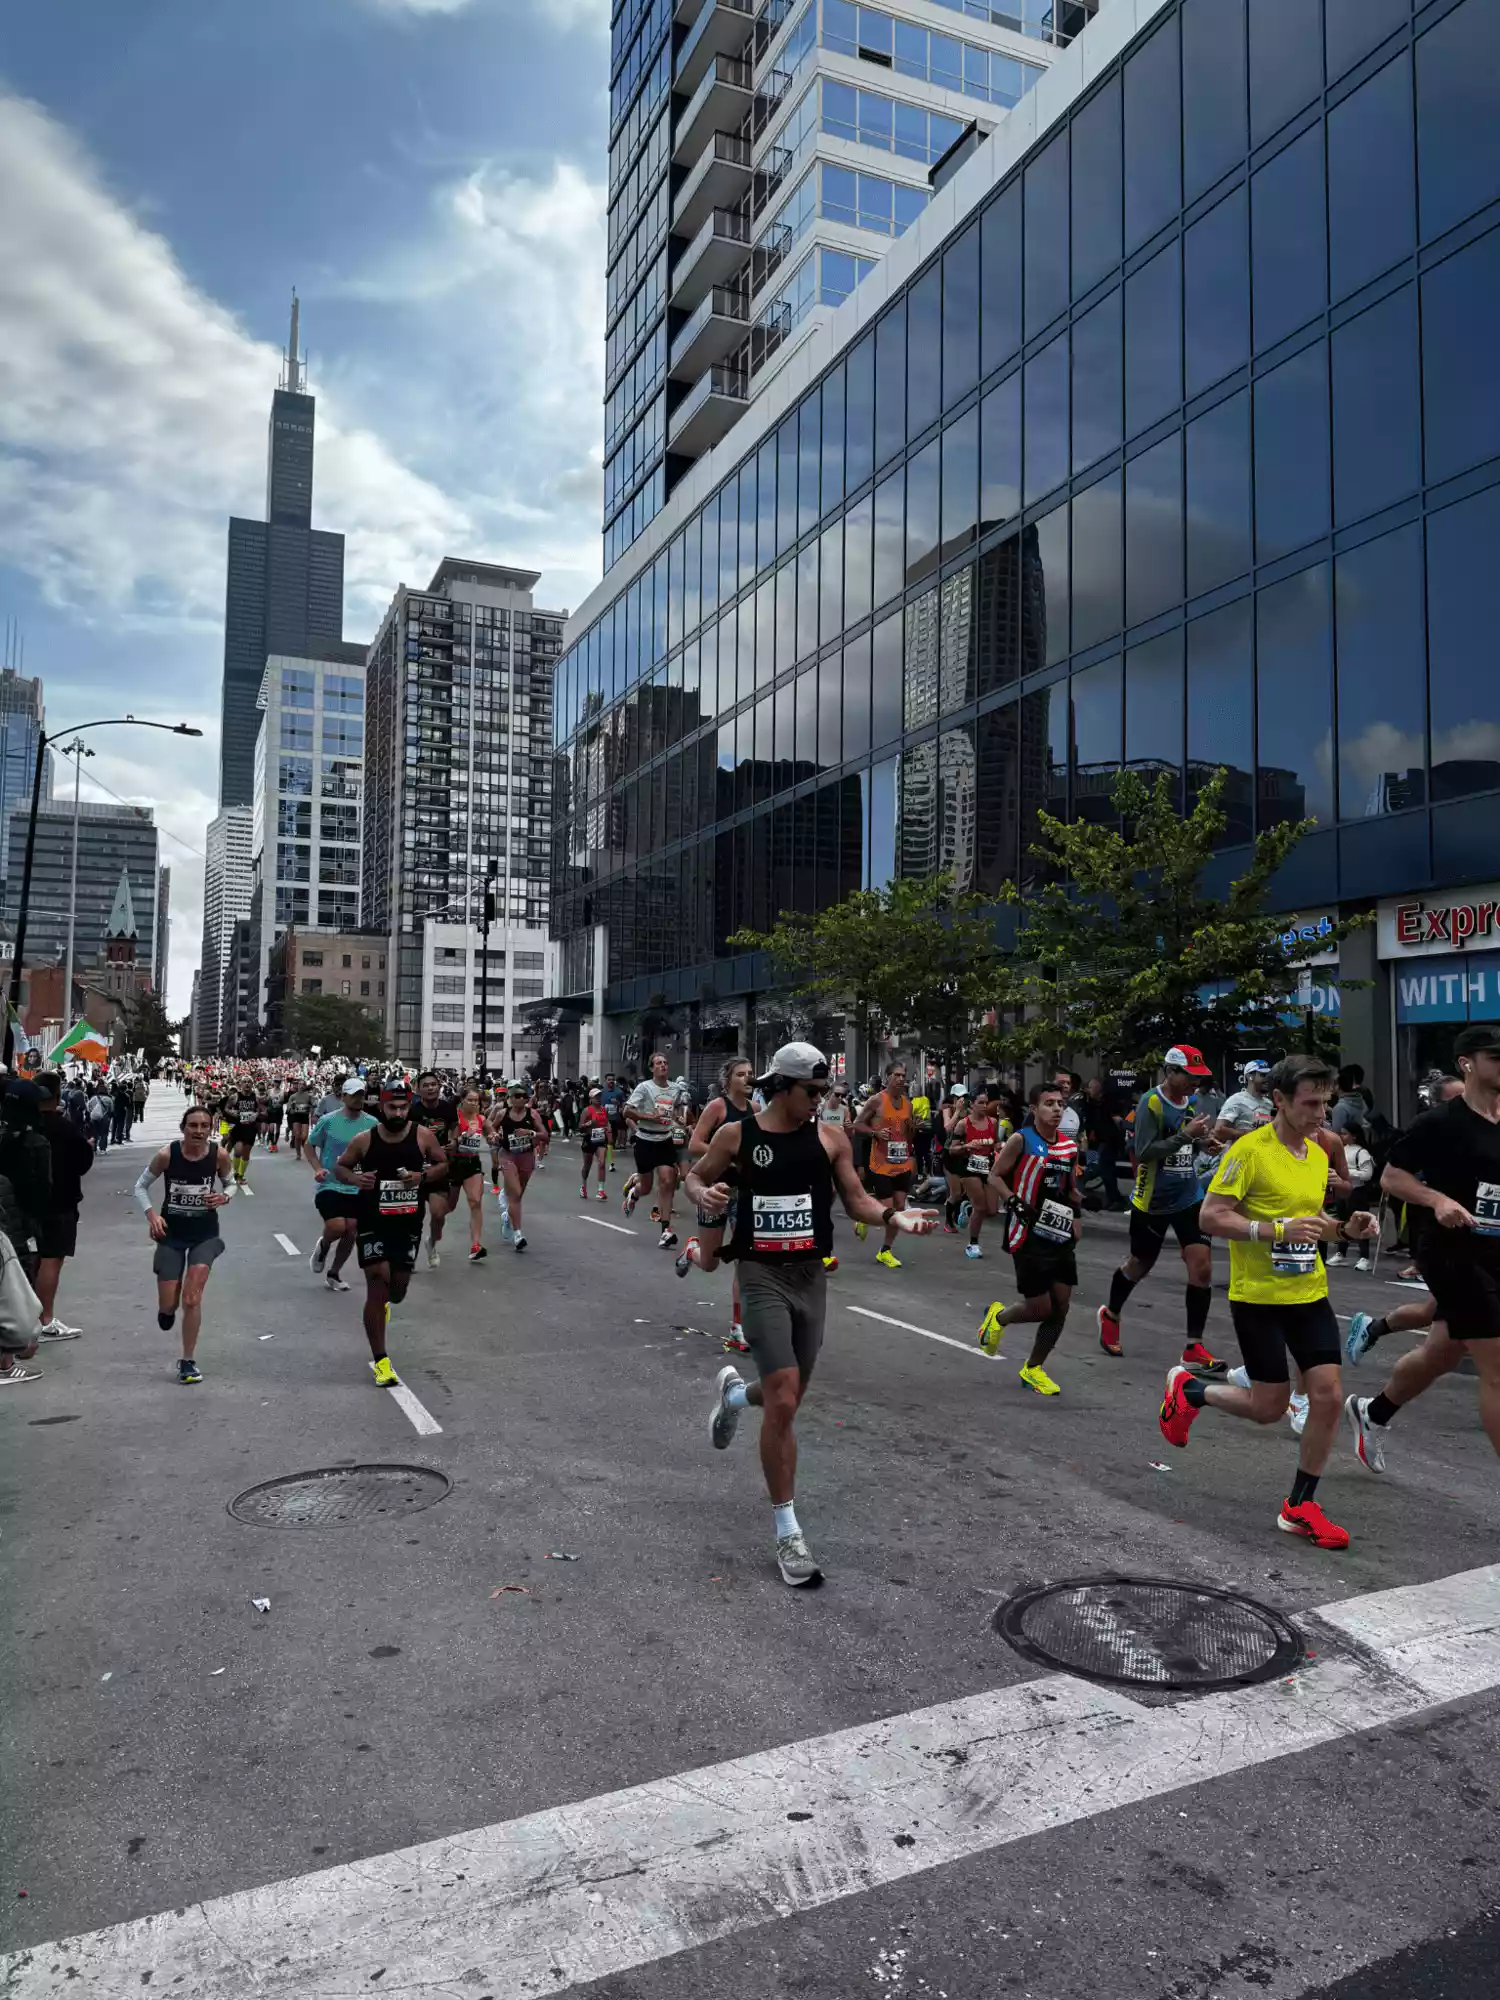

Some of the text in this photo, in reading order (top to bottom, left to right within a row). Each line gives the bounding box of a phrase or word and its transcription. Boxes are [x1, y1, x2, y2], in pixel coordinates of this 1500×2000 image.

[1396, 901, 1500, 947] Expr
[1272, 916, 1334, 955] est
[1401, 972, 1486, 1007] WITH
[758, 1149, 769, 1162] B
[170, 1194, 204, 1206] E 896
[380, 1190, 418, 1201] A 14085
[1475, 1200, 1487, 1215] E
[754, 1211, 812, 1229] D 14545
[1039, 1210, 1073, 1232] E 7917
[363, 1241, 384, 1258] BC
